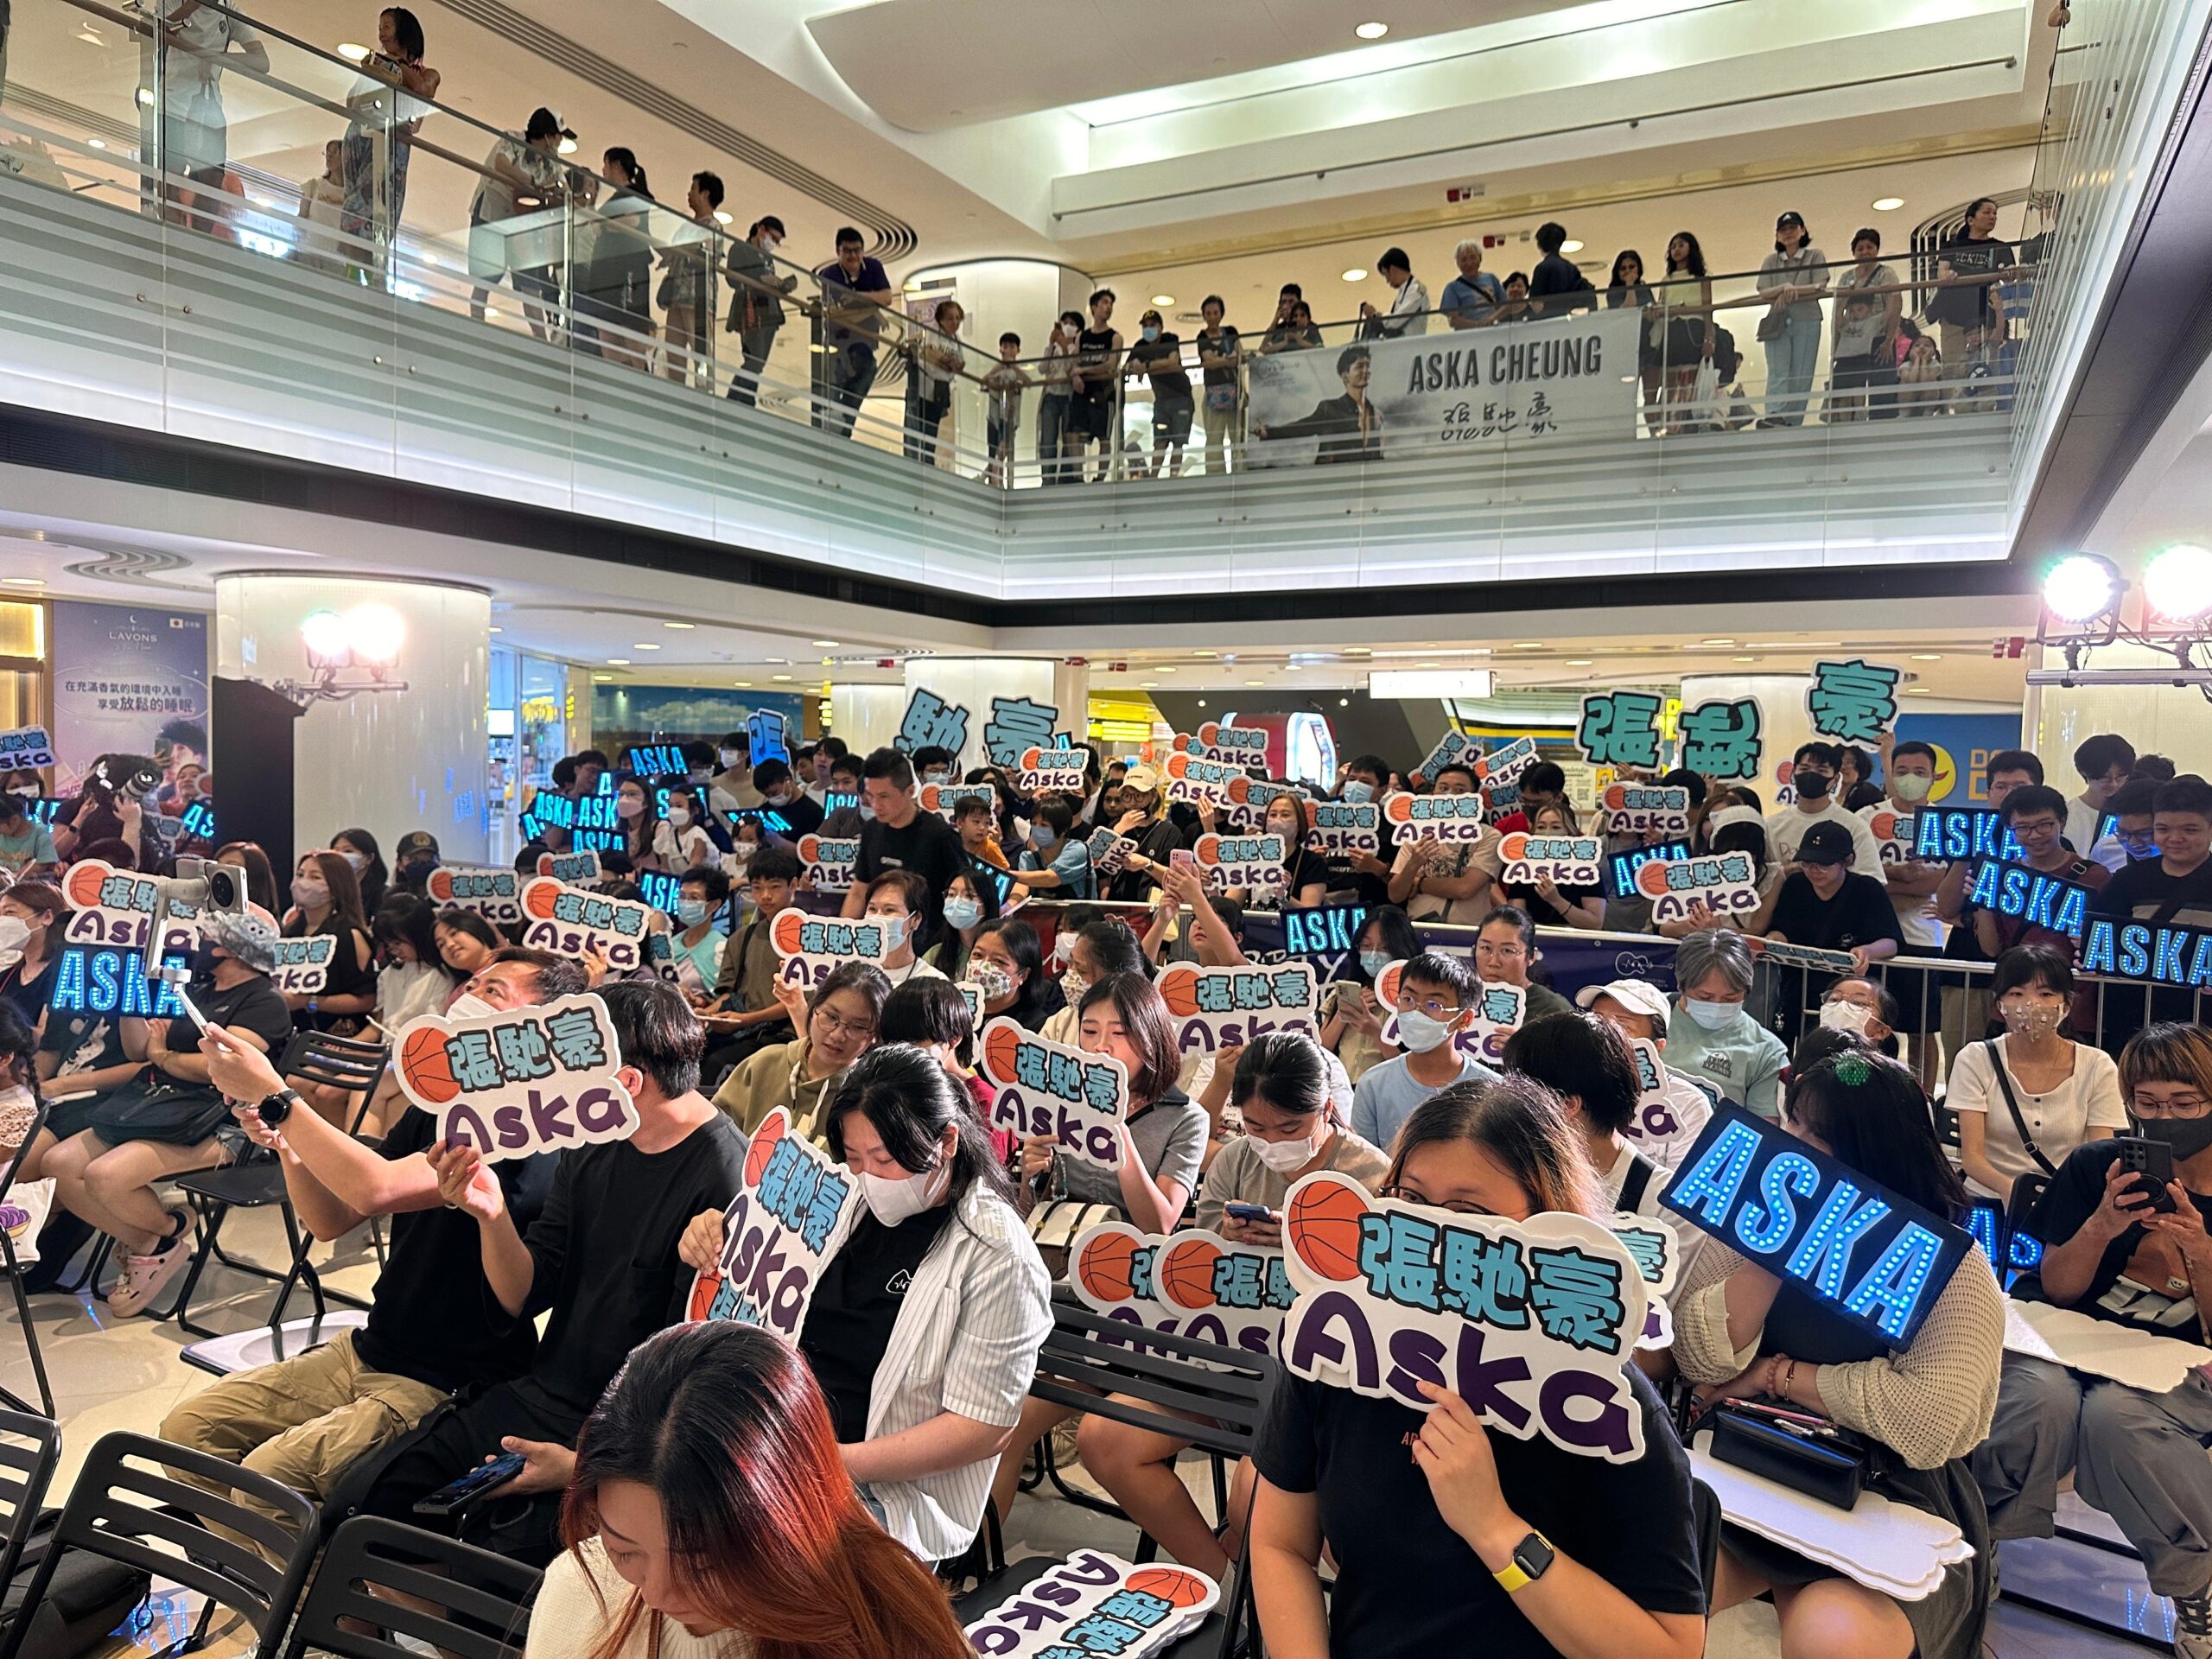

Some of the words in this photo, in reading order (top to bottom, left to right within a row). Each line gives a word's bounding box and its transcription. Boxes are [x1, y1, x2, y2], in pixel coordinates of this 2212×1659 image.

[1408, 346, 1479, 395] ASKA
[1488, 335, 1602, 386] CHEUNG
[109, 631, 157, 643] LAVONS
[65, 680, 181, 696] 在充滿香氣的環境中入睡
[98, 696, 193, 713] 享受放鬆的睡眠
[1809, 659, 1900, 741] 豪
[0, 731, 46, 753] 馳豪
[986, 696, 1058, 768] 豪
[1580, 692, 1662, 769] 張
[0, 752, 52, 769] ska
[630, 746, 688, 777] ASKA
[1205, 747, 1265, 766] Aska
[1023, 772, 1080, 787] Aska
[183, 804, 214, 838] AS
[534, 791, 573, 830] ASKA
[577, 796, 620, 829] ASK
[1232, 806, 1265, 826] As
[1612, 810, 1688, 833] Aska
[1217, 839, 1282, 863] 張馳豪
[1305, 830, 1376, 850] Aska
[1396, 823, 1478, 842] Aska
[1523, 838, 1598, 861] 張馳豪
[1917, 811, 2025, 861] ASKA
[817, 842, 861, 863] 張馳
[809, 866, 855, 884] Ask
[1210, 865, 1284, 887] Aska
[1508, 862, 1596, 885] Aska
[1664, 855, 1751, 892] 張馳豪
[641, 873, 680, 916] ASK
[1655, 886, 1758, 920] Aska
[1971, 860, 2087, 938] ASKA
[553, 893, 645, 937] 張馳豪
[528, 921, 635, 965] Aska
[799, 922, 882, 957] 張馳豪
[2086, 920, 2212, 986] ASKA
[52, 950, 186, 1016] ASKA
[271, 968, 326, 990] ska
[784, 957, 842, 987] As
[1196, 969, 1310, 1013] 張馳豪
[443, 1006, 606, 1093] 張馳豪
[1014, 1041, 1120, 1116] 張馳豪
[445, 1087, 628, 1155] Aska
[995, 1087, 1119, 1164] Aska
[756, 1136, 850, 1257] 張馳豪
[1672, 1118, 1944, 1339] ASKA
[721, 1193, 809, 1335] Aska
[1211, 1251, 1294, 1308] 張馳
[1357, 1209, 1625, 1355] 張馳豪
[1180, 1311, 1286, 1360] As
[1291, 1290, 1634, 1456] Aska
[970, 1553, 1120, 1656] Aska
